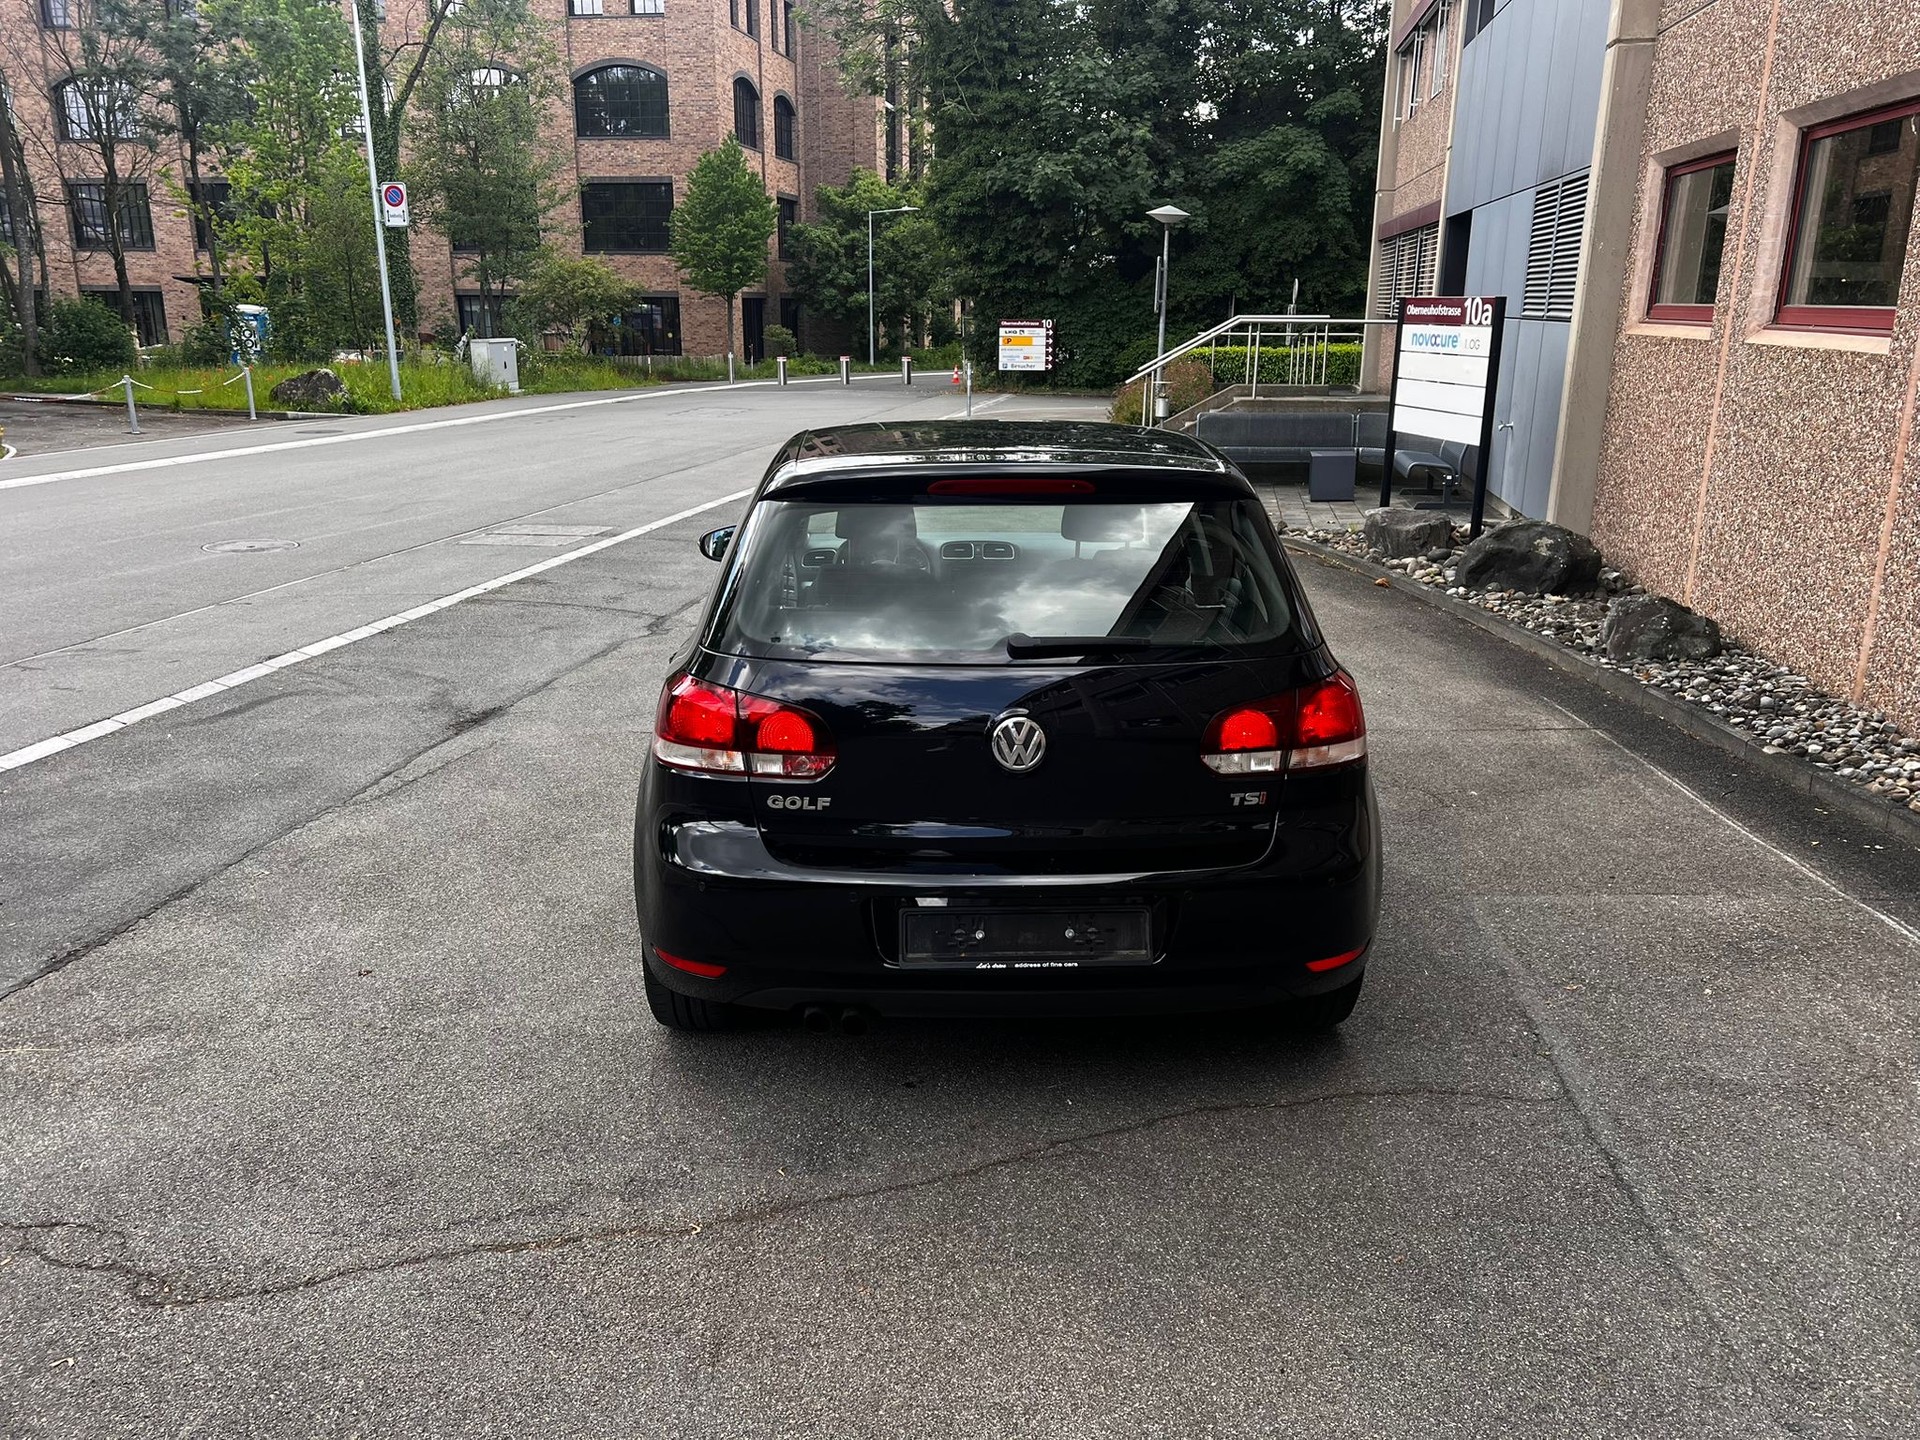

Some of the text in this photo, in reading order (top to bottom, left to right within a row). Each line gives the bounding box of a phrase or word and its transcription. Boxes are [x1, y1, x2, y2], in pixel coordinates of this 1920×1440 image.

[1406, 297, 1493, 325] Oberneuhofstrasse 10a
[1042, 319, 1052, 328] 10
[1411, 332, 1459, 349] novocure
[767, 795, 832, 811] GOLF
